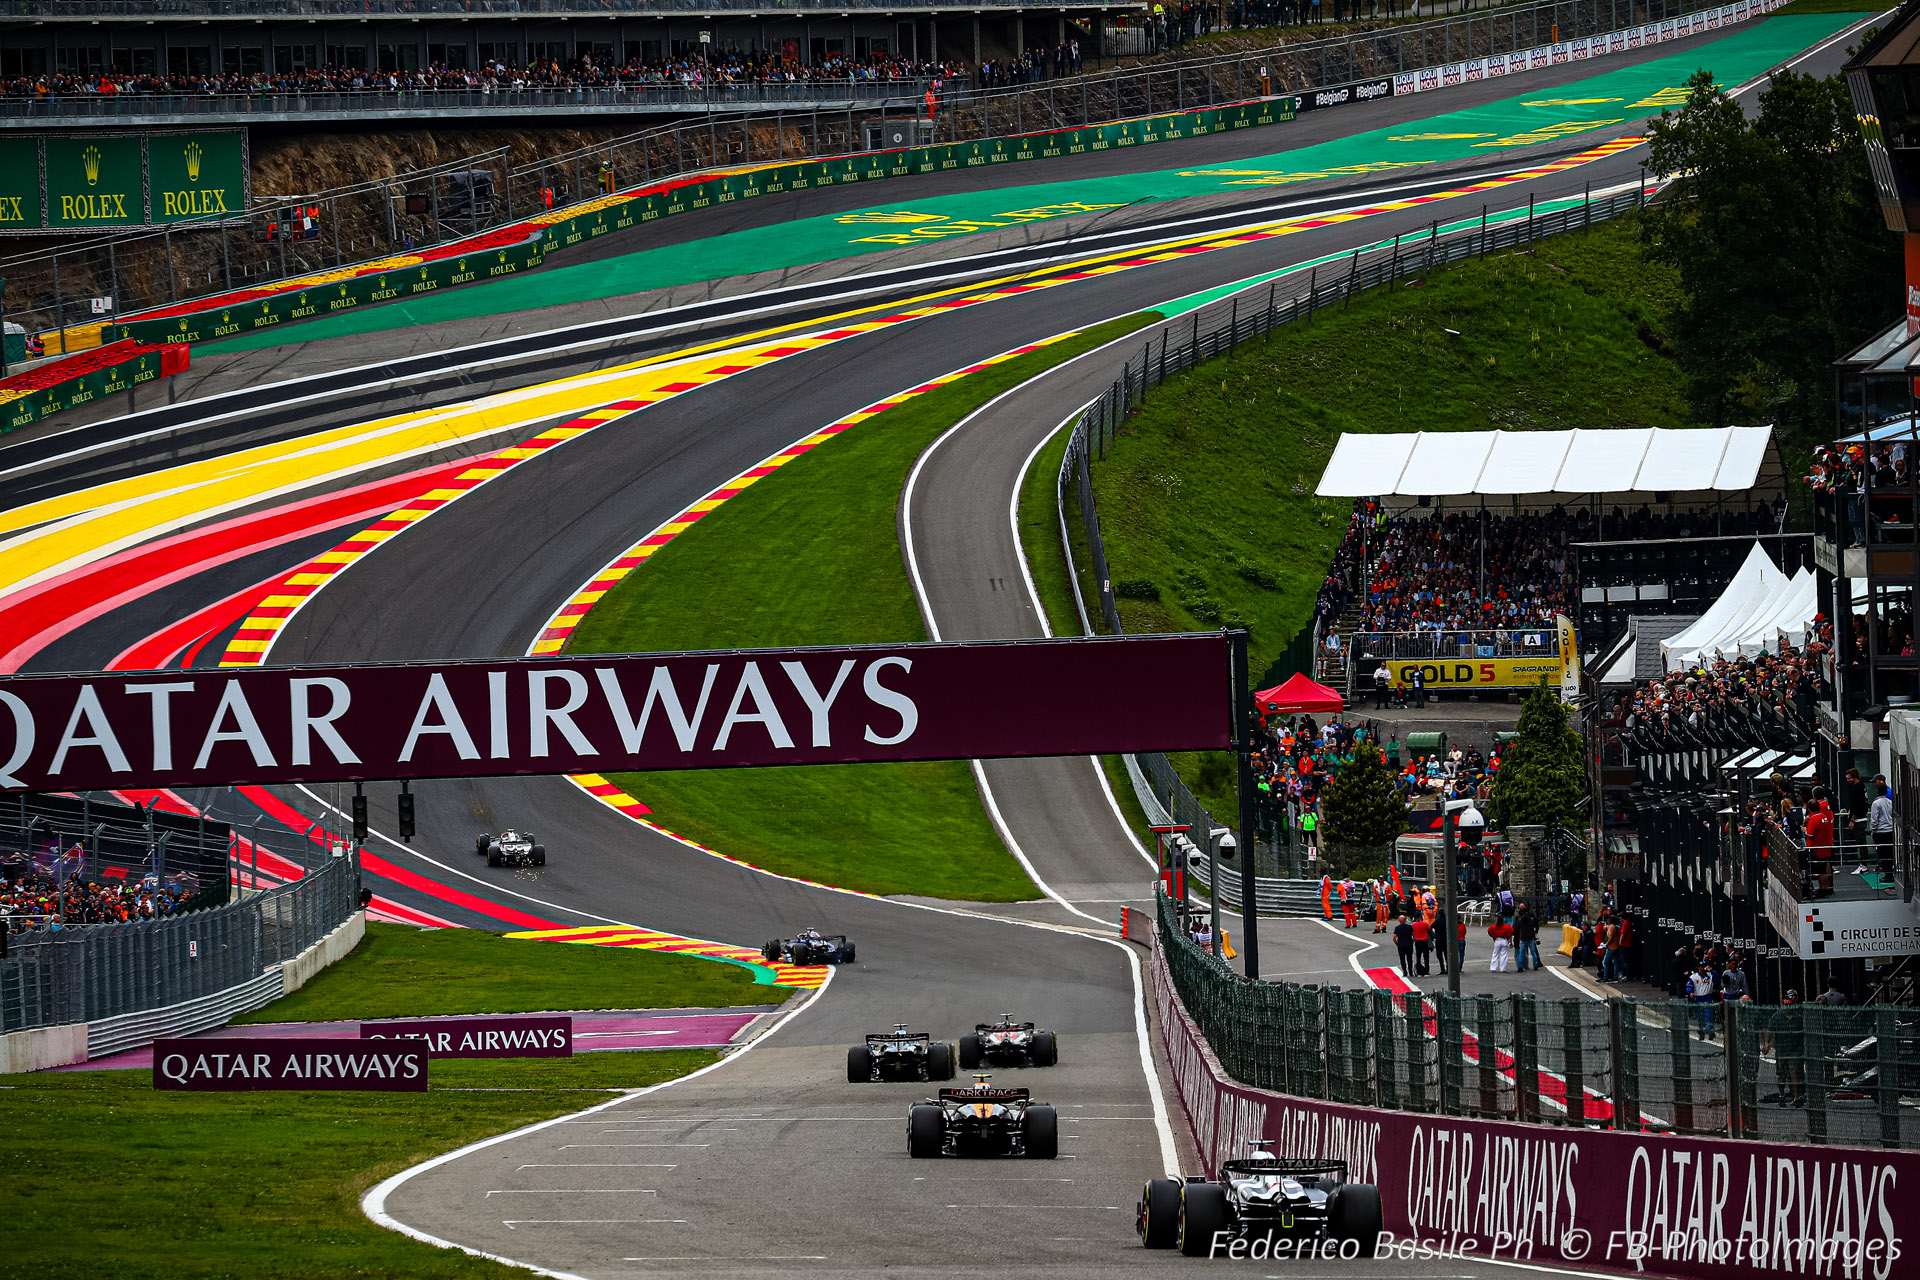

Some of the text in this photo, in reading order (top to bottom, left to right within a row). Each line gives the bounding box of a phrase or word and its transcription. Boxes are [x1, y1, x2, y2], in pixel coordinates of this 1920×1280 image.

[1592, 36, 1606, 46] LIQUI
[1610, 32, 1623, 42] LIQUI
[1552, 43, 1567, 53] LIQUI
[1573, 40, 1587, 50] LIQUI
[1592, 45, 1606, 56] MOLY
[1611, 42, 1624, 51] MOLY
[1510, 52, 1525, 62] LIQUI
[1532, 48, 1547, 58] LIQUI
[1553, 52, 1568, 63] MOLY
[1573, 49, 1587, 59] MOLY
[1466, 60, 1481, 71] LIQUI
[1488, 56, 1504, 67] LIQUI
[1510, 62, 1526, 72] MOLY
[1532, 58, 1547, 68] MOLY
[1420, 69, 1436, 80] LIQUI
[1443, 64, 1460, 75] LIQUI
[1489, 66, 1505, 76] MOLY
[1396, 74, 1413, 84] LIQUI
[1443, 75, 1461, 85] MOLY
[1466, 70, 1483, 81] MOLY
[1356, 82, 1388, 98] #BelgianGP
[1397, 83, 1414, 94] MOLY
[1420, 79, 1438, 90] MOLY
[1316, 89, 1348, 105] #BelgianGP
[991, 152, 1008, 162] ROLEX
[1017, 150, 1033, 160] ROLEX
[1044, 147, 1060, 157] ROLEX
[867, 169, 883, 178] ROLEX
[892, 166, 908, 175] ROLEX
[818, 176, 833, 185] ROLEX
[843, 172, 858, 181] ROLEX
[767, 183, 783, 193] ROLEX
[793, 179, 807, 188] ROLEX
[718, 192, 735, 202] ROLEX
[744, 187, 759, 197] ROLEX
[61, 194, 127, 219] ROLEX
[163, 189, 228, 215] ROLEX
[693, 198, 709, 208] ROLEX
[668, 203, 684, 214] ROLEX
[642, 210, 658, 221] ROLEX
[617, 217, 633, 229] ROLEX
[849, 201, 1129, 245] ROLEX
[592, 224, 608, 236] ROLEX
[567, 231, 582, 244] ROLEX
[490, 262, 516, 276] ROLEX
[452, 271, 474, 284] ROLEX
[413, 280, 437, 292] ROLEX
[372, 288, 397, 300] ROLEX
[330, 297, 356, 310] ROLEX
[292, 306, 315, 318] ROLEX
[255, 314, 279, 327] ROLEX
[215, 323, 240, 336] ROLEX
[168, 332, 200, 343] ROLEX
[134, 370, 154, 382] ROLEX
[105, 380, 125, 394] ROLEX
[72, 390, 93, 405] ROLEX
[42, 401, 61, 415] ROLEX
[13, 413, 32, 427] ROLEX
[1528, 636, 1536, 644] A
[1400, 664, 1495, 683] GOLD 5
[398, 656, 918, 762] AIRWAYS
[1841, 928, 1889, 940] CIRCUIT
[1893, 927, 1909, 937] DE
[1735, 939, 1743, 948] 32
[1746, 940, 1755, 948] 31
[1758, 945, 1766, 954] 30
[1769, 949, 1778, 957] 29
[1781, 948, 1790, 956] 28
[459, 1029, 565, 1051] AIRWAYS
[162, 1054, 419, 1084] QATAR AIRWAYS
[1280, 1106, 1380, 1186] QATAR AIRWAYS
[1238, 1160, 1334, 1168] ALPHATAURI
[1408, 1125, 1579, 1249] QATAR AIRWAYS
[1626, 1146, 1896, 1280] QATAR AIRWAYS
